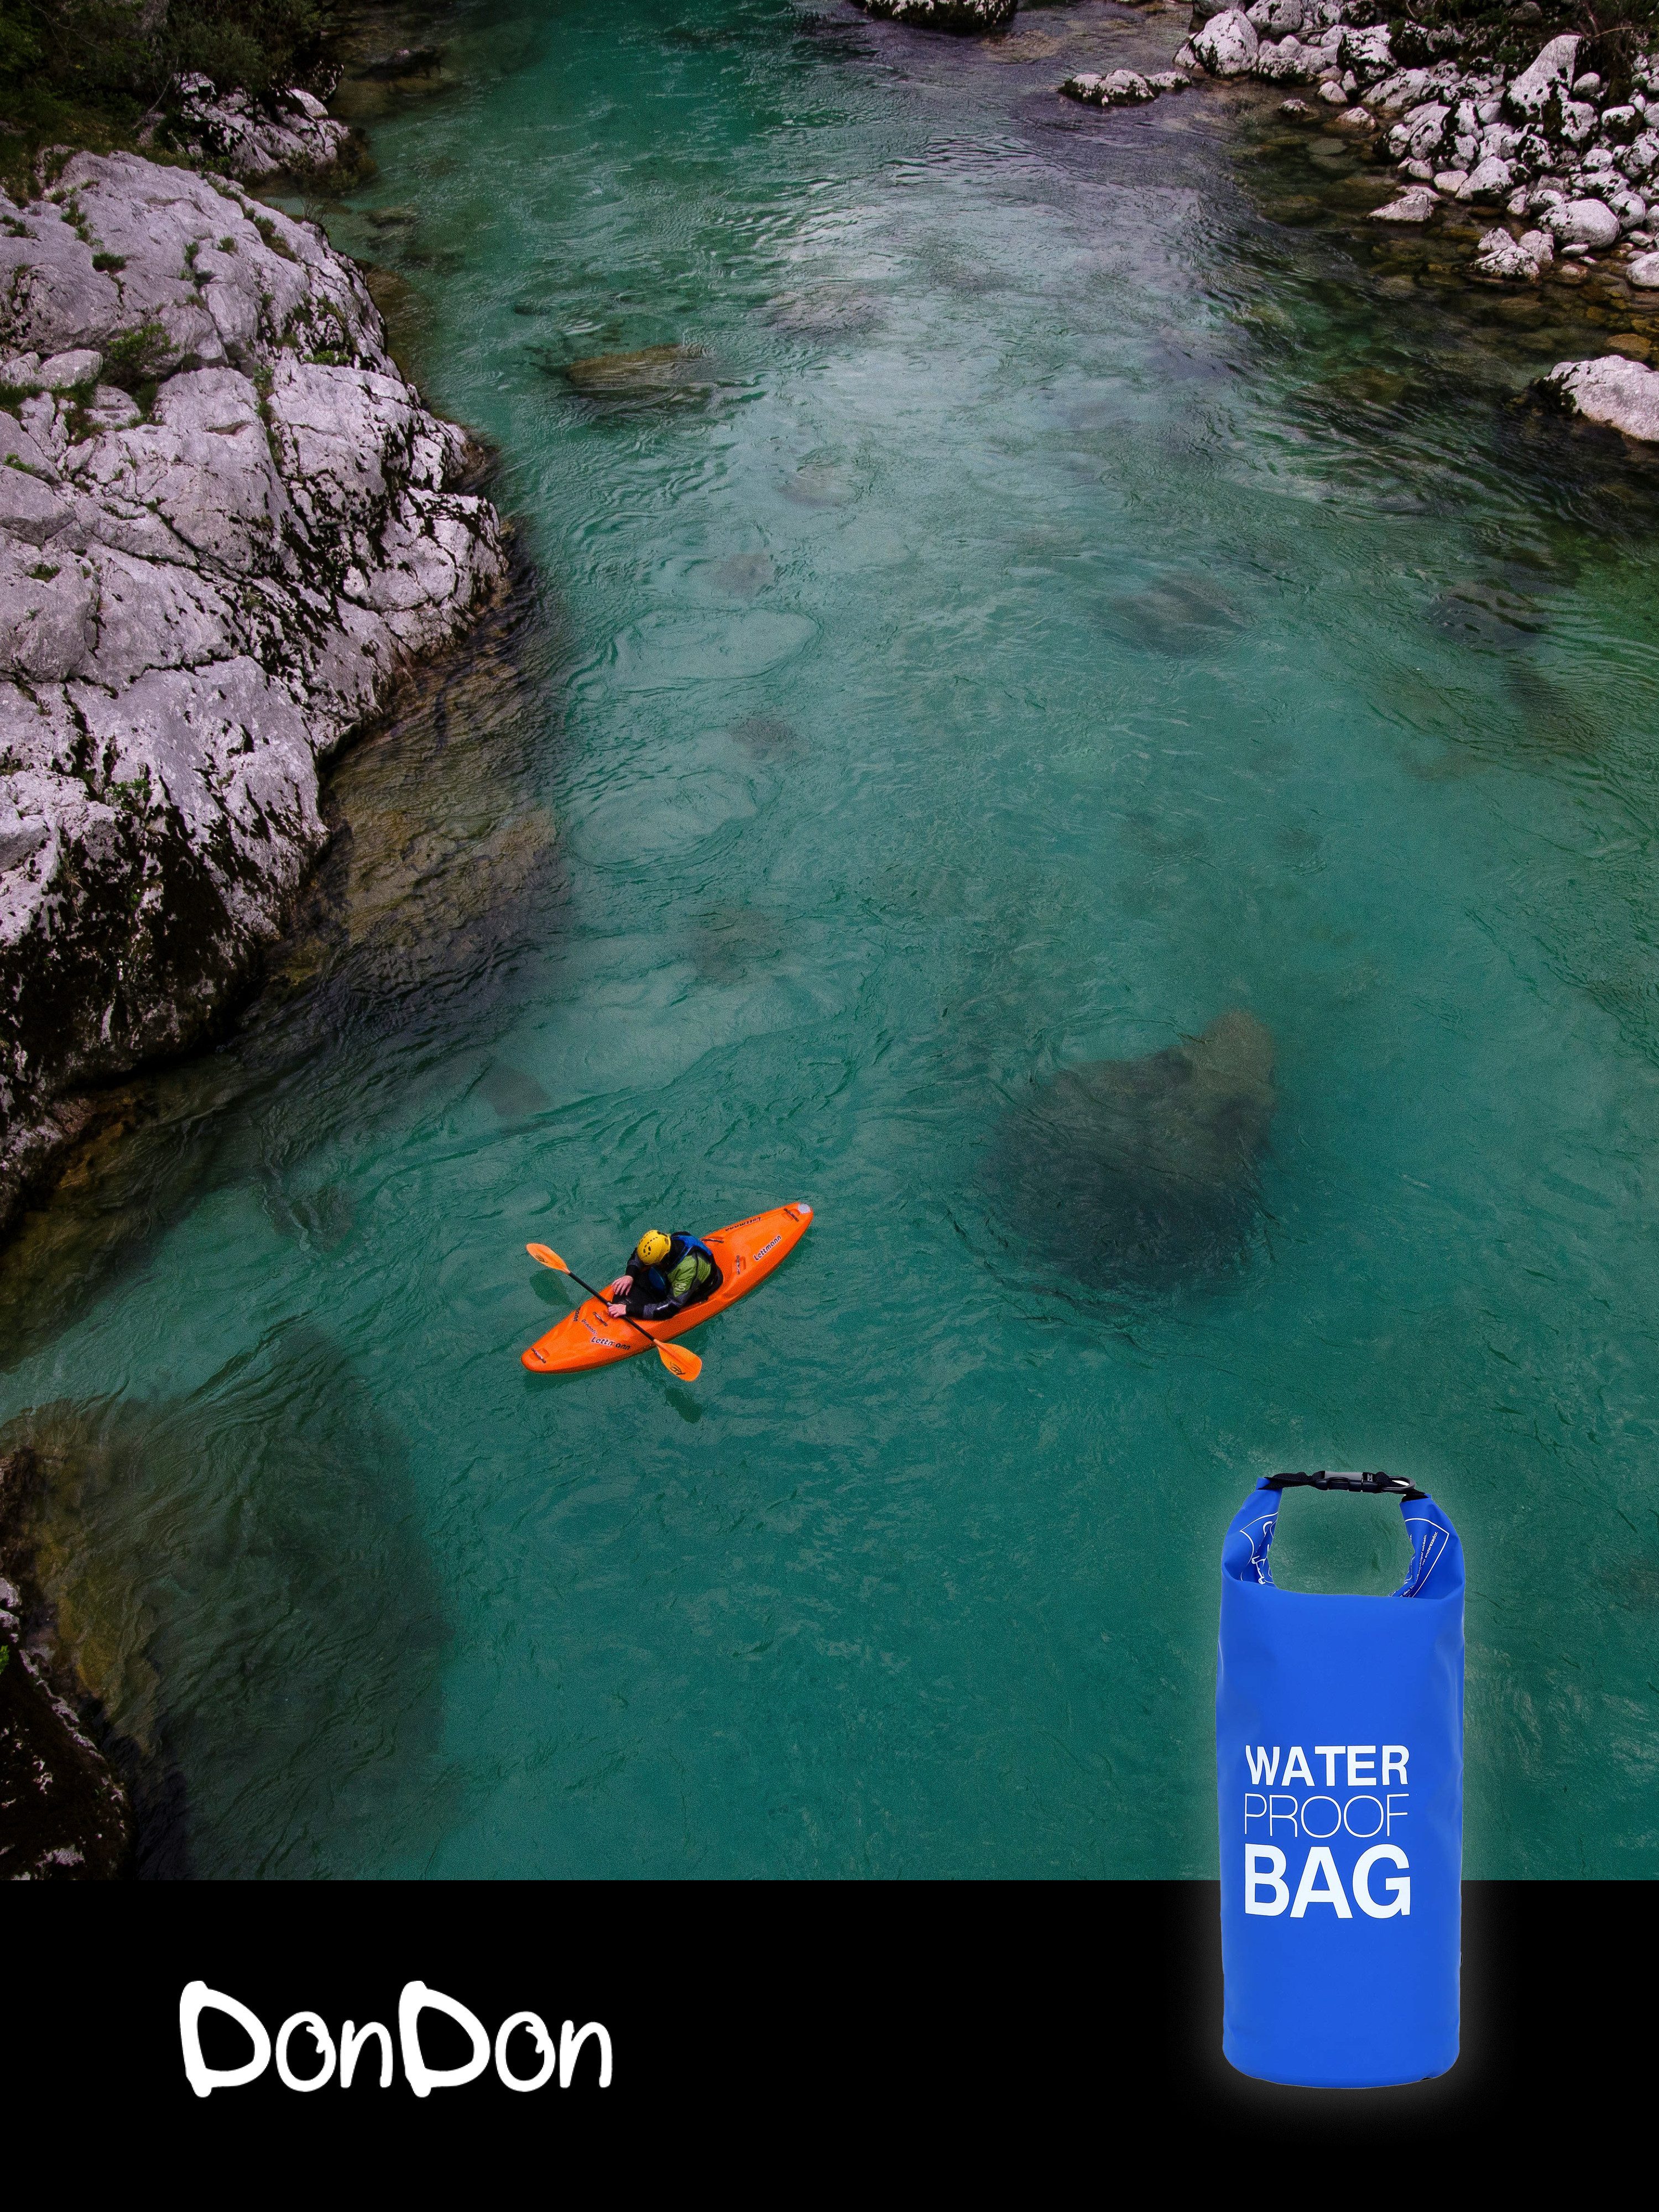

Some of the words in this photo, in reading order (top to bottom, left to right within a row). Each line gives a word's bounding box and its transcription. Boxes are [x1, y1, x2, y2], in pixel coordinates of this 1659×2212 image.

[753, 1235, 781, 1261] Lettmann
[1425, 1531, 1438, 1558] enderezador.
[1245, 1745, 1410, 1787] WATER
[1244, 1793, 1410, 1839] PROOF
[1244, 1843, 1411, 1919] BAG
